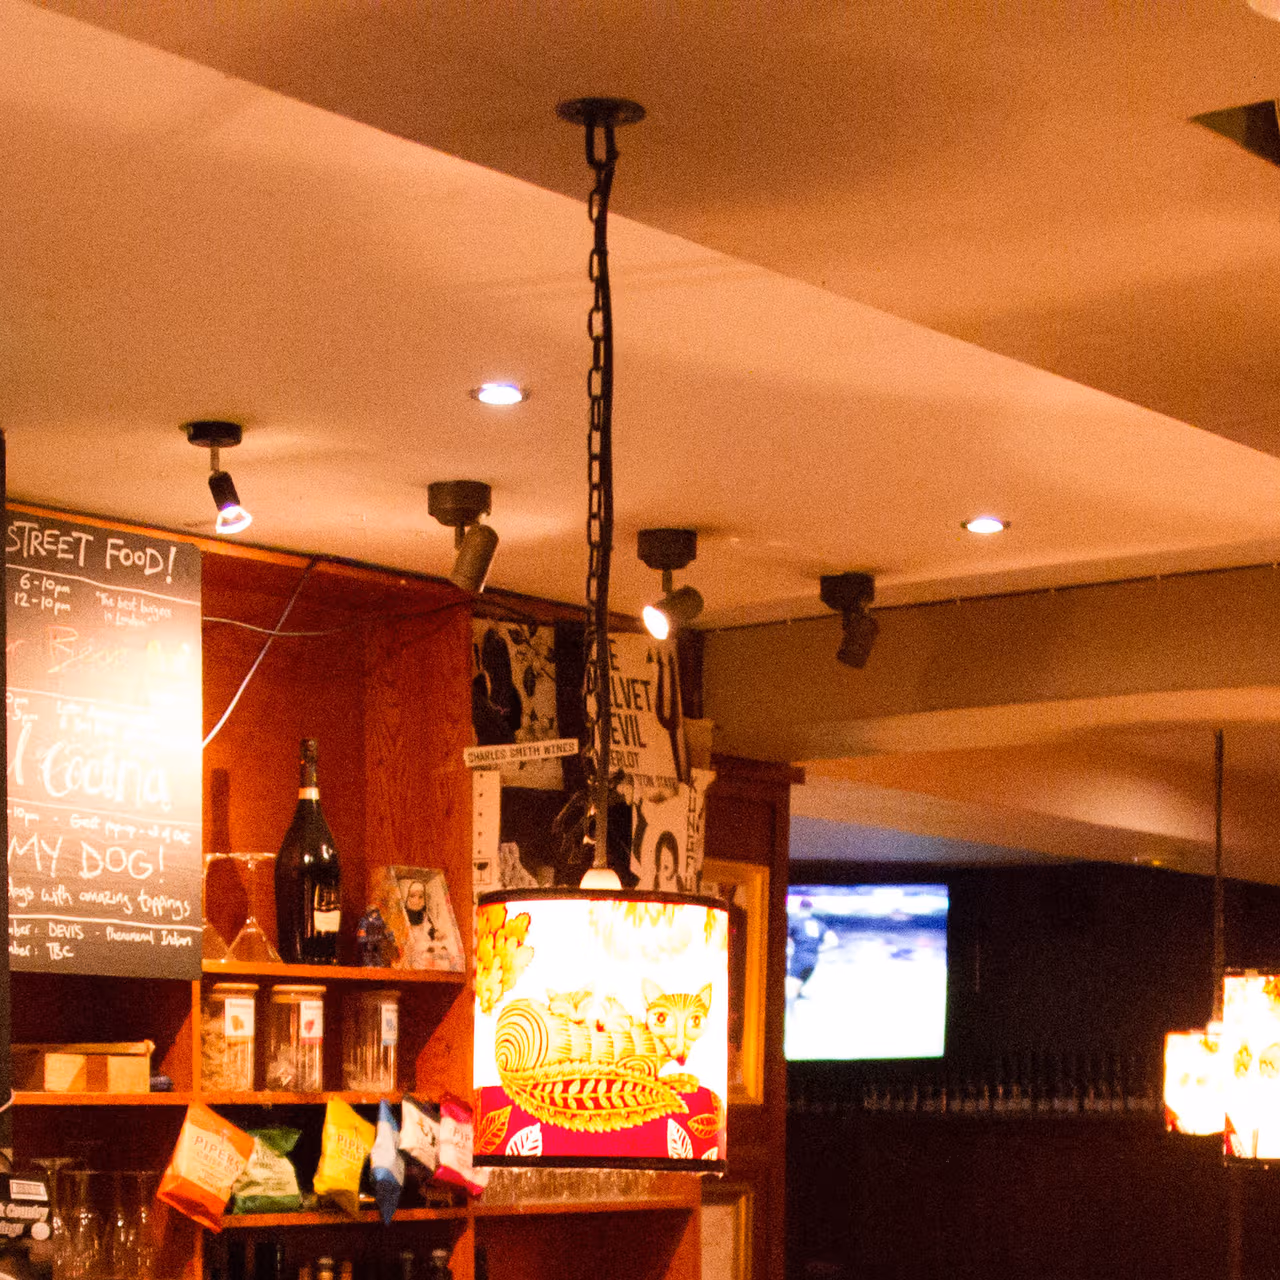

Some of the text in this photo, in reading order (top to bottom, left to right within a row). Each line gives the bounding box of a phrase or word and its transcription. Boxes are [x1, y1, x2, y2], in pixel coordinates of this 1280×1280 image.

[6, 520, 178, 585] STREET FOOD!
[608, 675, 651, 711] LVET
[608, 713, 647, 749] EVIL
[608, 750, 640, 767] ERLOT
[79, 840, 164, 884] DOG!
[78, 890, 134, 915] amazing
[136, 888, 192, 921] toppings
